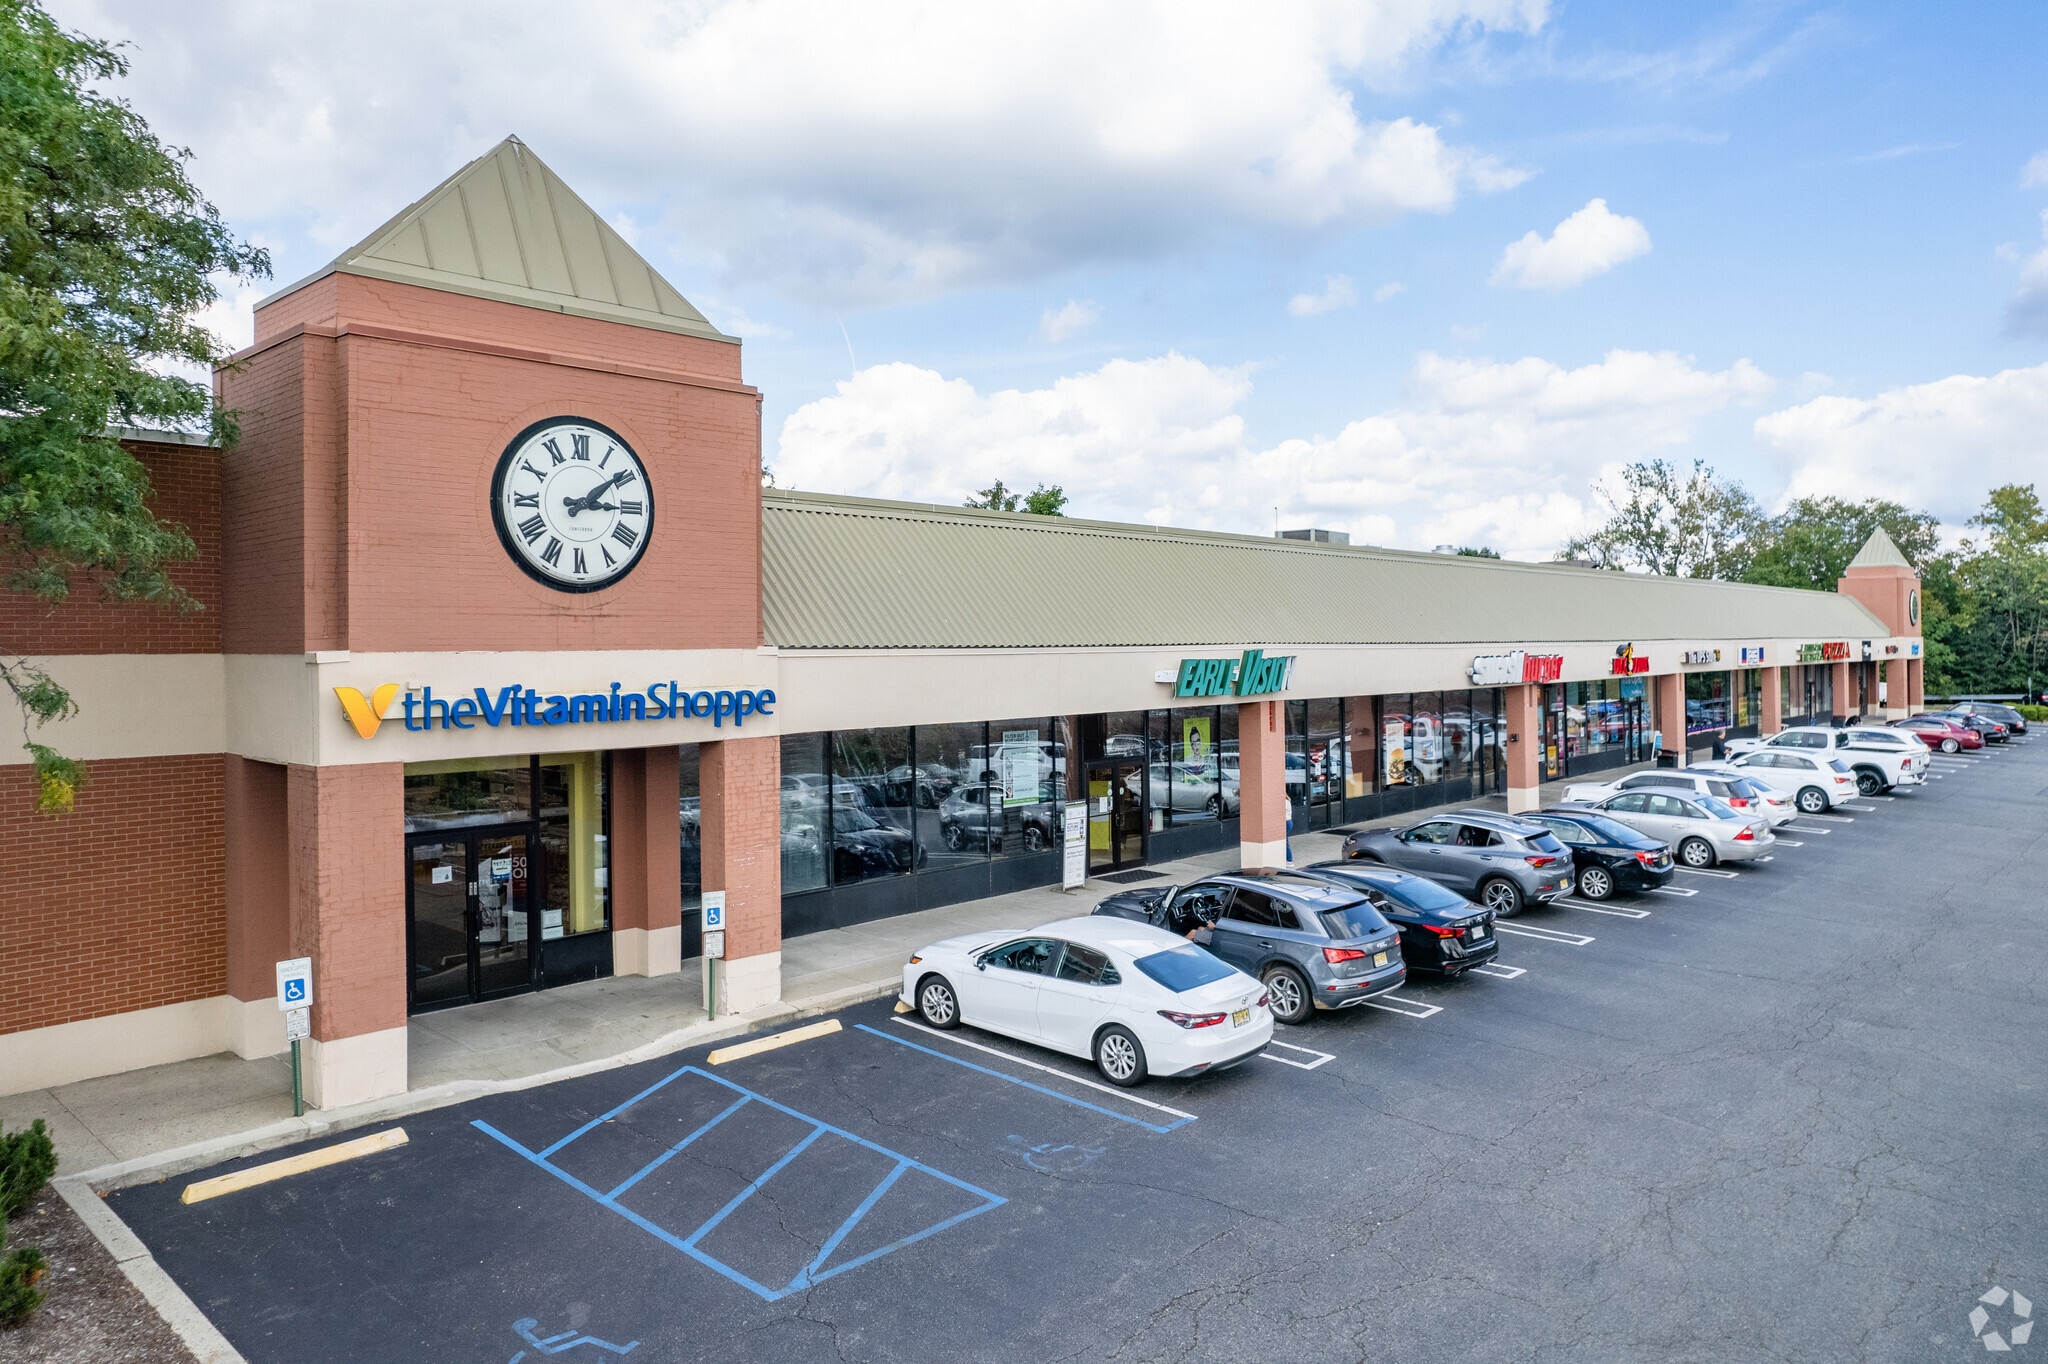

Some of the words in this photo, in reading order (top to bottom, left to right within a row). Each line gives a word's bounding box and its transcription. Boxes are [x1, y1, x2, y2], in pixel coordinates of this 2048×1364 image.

[542, 437, 566, 467] XI
[571, 433, 590, 461] XII
[598, 446, 614, 470] I
[521, 459, 548, 483] X
[514, 490, 540, 509] IX
[620, 499, 642, 516] III
[1823, 641, 1851, 660] PIZZA
[1176, 658, 1240, 697] EARLE
[402, 680, 777, 732] theVitaminShoppe
